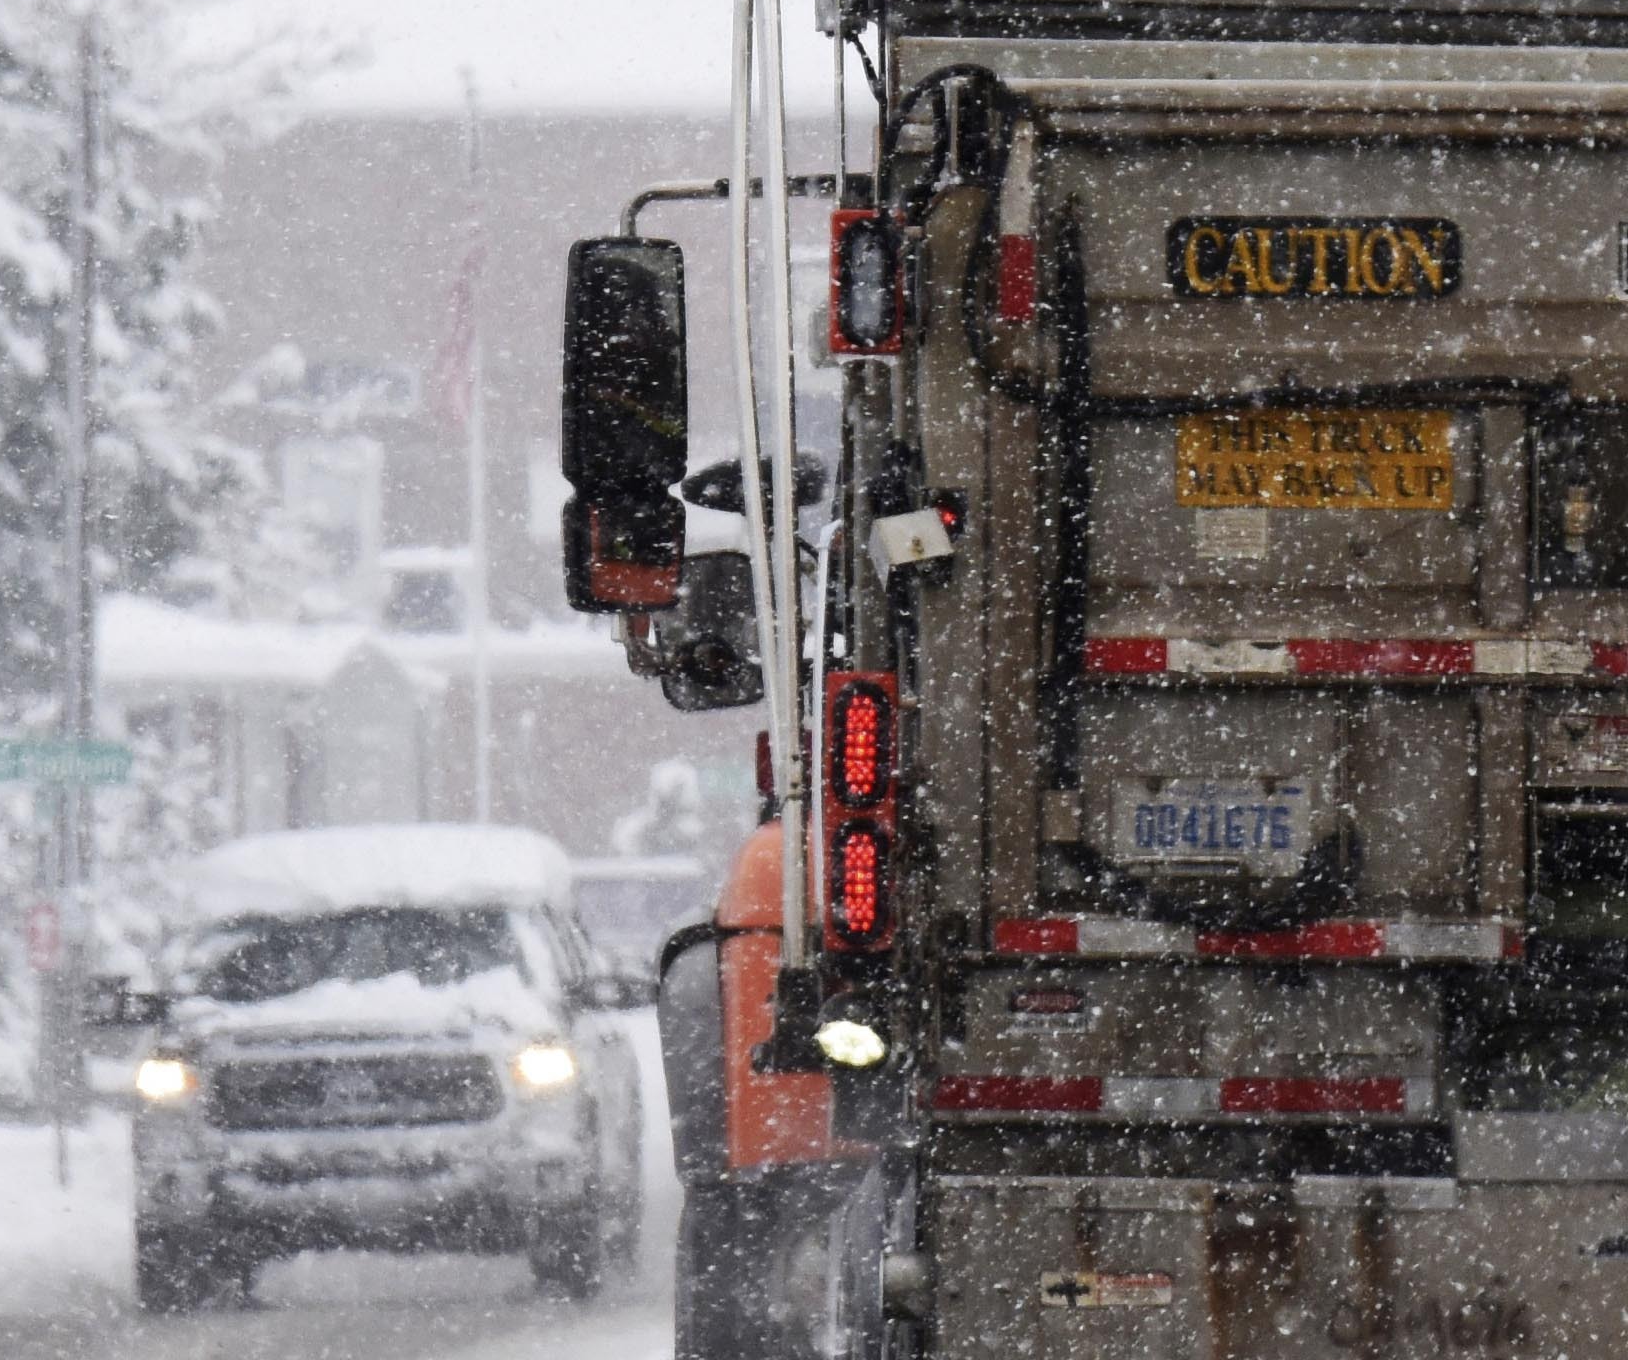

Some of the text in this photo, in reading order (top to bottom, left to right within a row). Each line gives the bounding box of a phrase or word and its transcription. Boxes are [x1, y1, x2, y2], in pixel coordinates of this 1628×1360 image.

[1183, 226, 1445, 294] CAUTION
[1205, 419, 1425, 454] THIS TRUCK
[1184, 462, 1448, 498] MAY BACK UP
